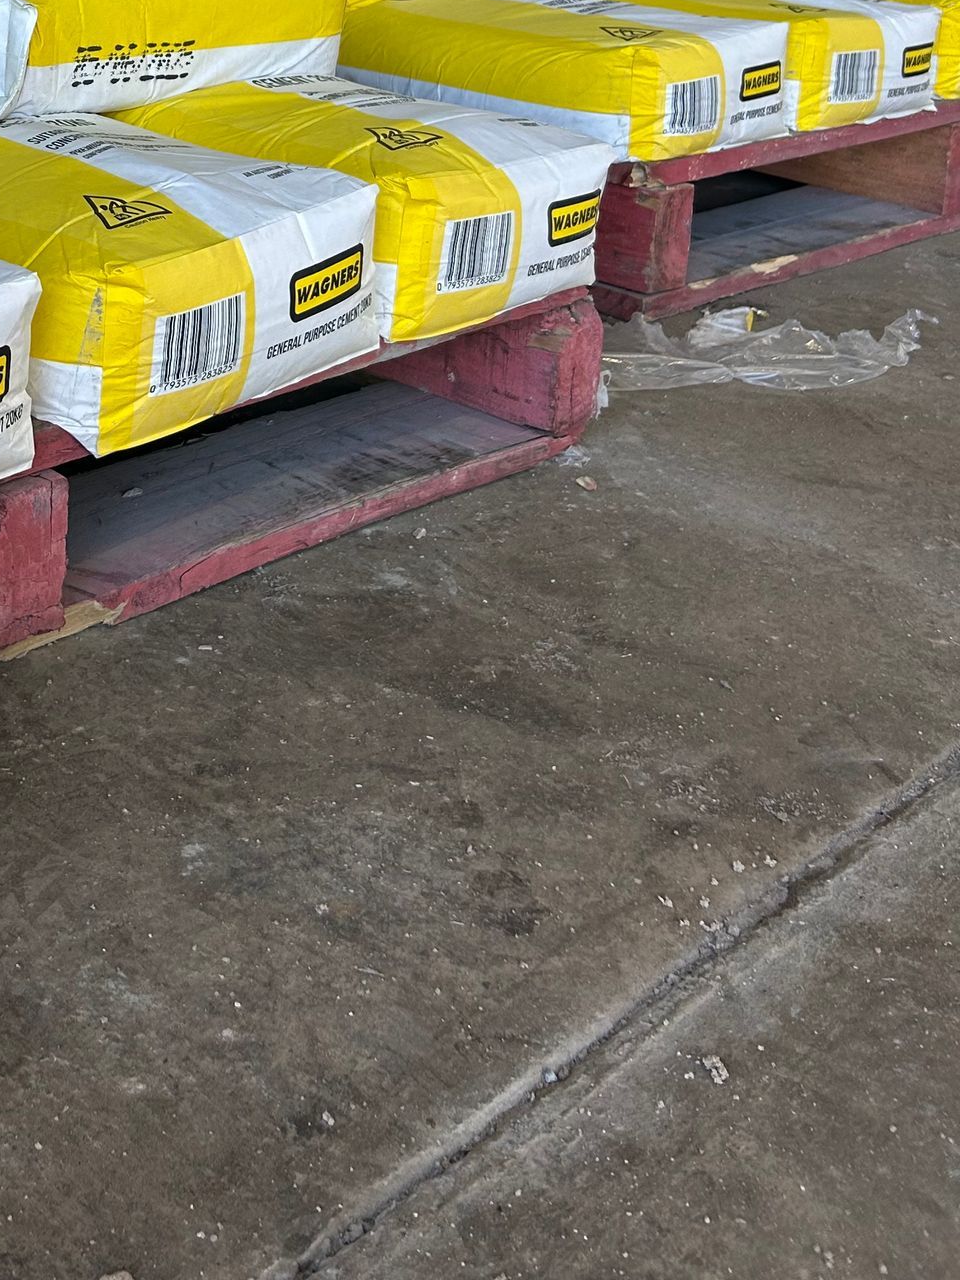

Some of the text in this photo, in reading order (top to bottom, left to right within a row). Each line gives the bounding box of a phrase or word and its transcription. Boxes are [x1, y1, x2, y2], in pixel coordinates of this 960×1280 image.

[744, 70, 780, 91] WAGNERS
[528, 260, 555, 276] GENERAL
[555, 252, 580, 269] PURPOSE
[297, 260, 360, 305] WAGNERS
[437, 283, 441, 291] 0
[447, 278, 474, 290] 793573
[267, 335, 302, 359] GENERAL
[304, 320, 336, 345] PURPOSE
[336, 307, 360, 330] CEMENT
[150, 385, 156, 393] 0
[164, 376, 198, 390] 793573
[5, 403, 24, 429] 20KG
